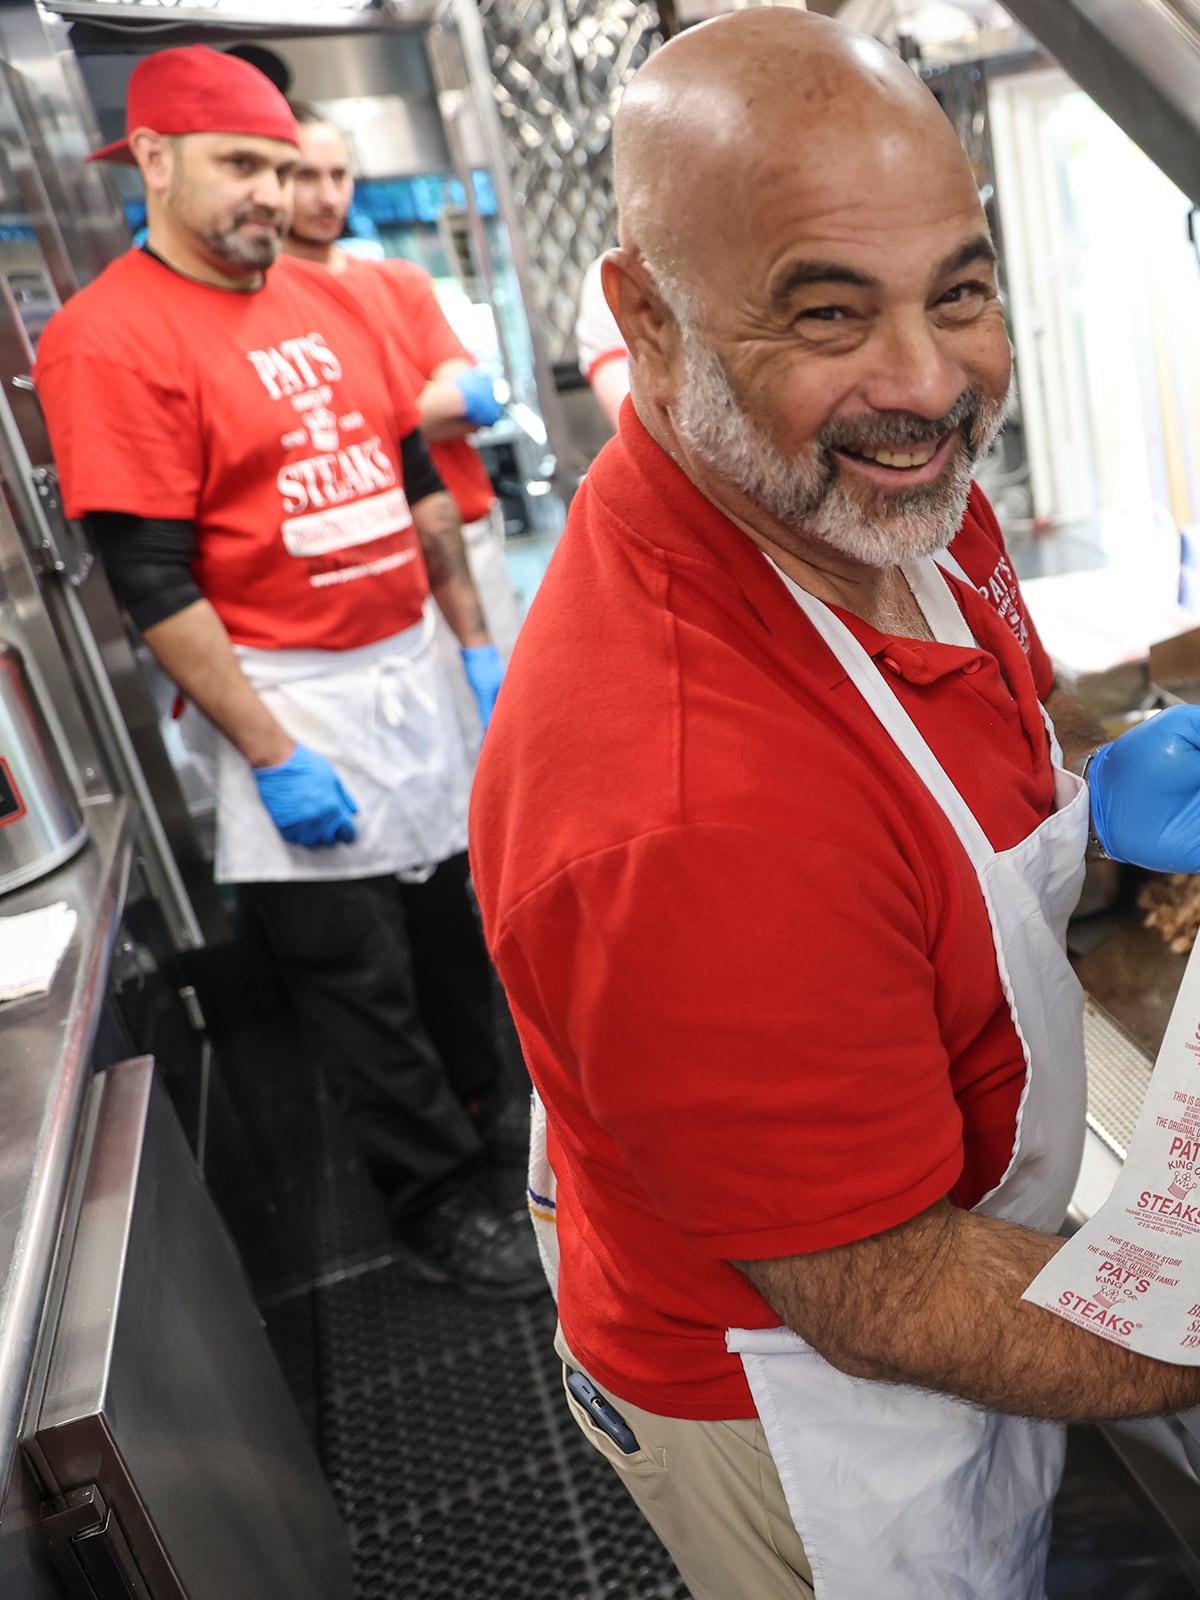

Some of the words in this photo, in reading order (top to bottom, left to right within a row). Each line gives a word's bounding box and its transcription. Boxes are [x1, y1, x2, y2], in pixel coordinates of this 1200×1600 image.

[277, 435, 396, 514] STEAKS
[1173, 1091, 1187, 1102] THIS
[1187, 1095, 1194, 1105] IS
[1156, 1117, 1168, 1128] THE
[1167, 1120, 1194, 1136] ORIGINAL
[1168, 1161, 1193, 1170] KING
[1098, 1261, 1150, 1293] PAT'S
[1096, 1276, 1123, 1289] KING
[1123, 1289, 1137, 1301] OF
